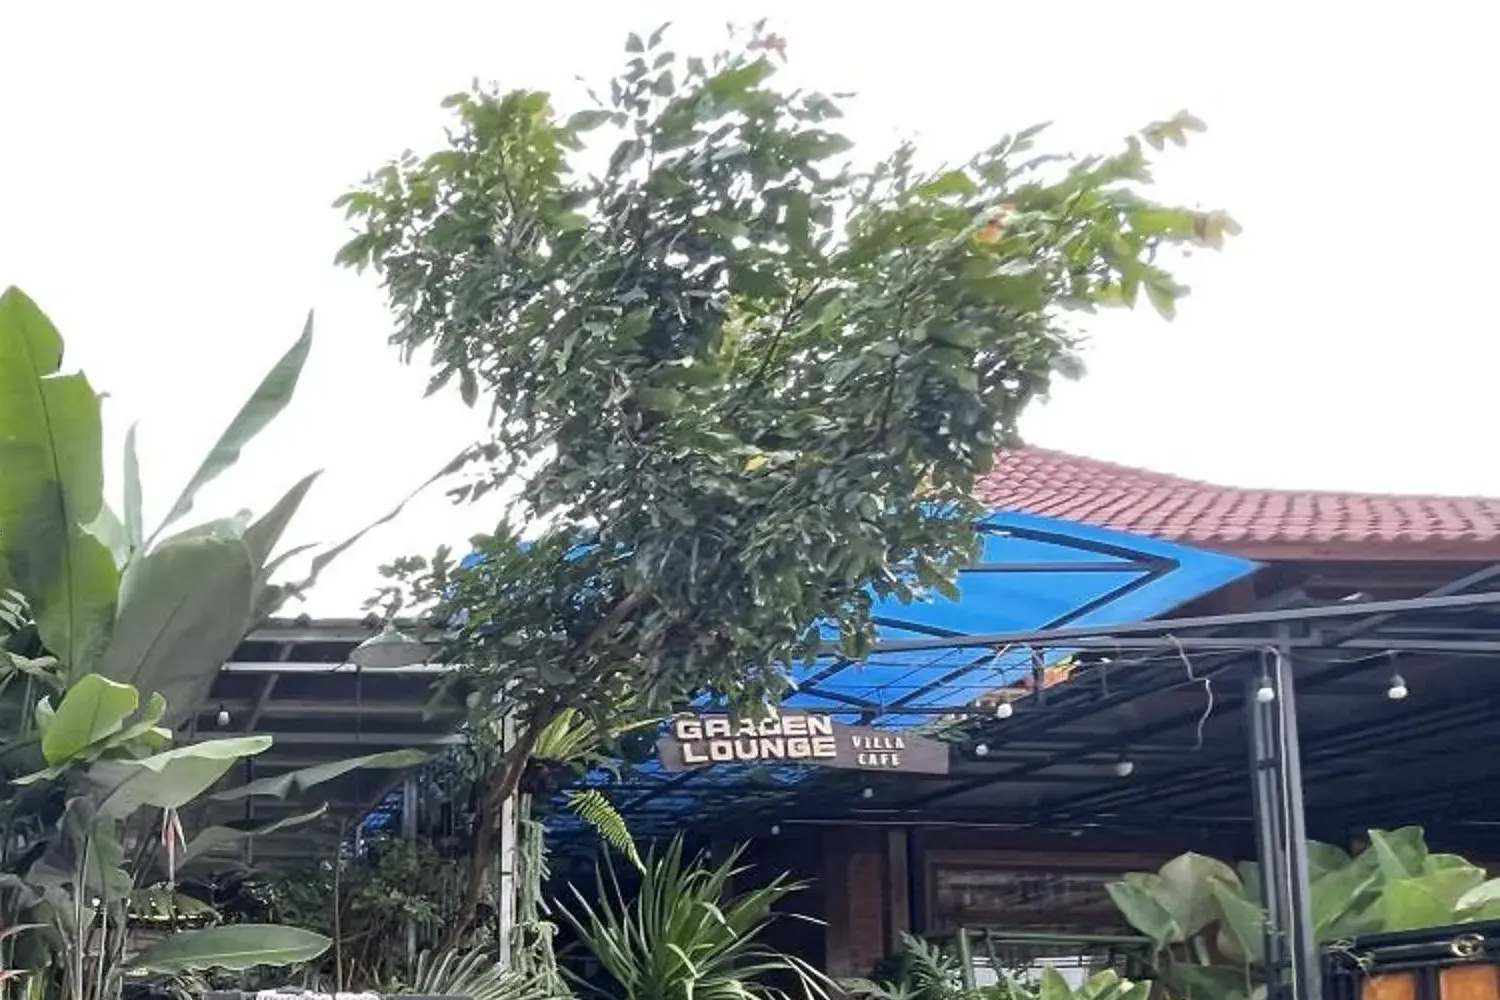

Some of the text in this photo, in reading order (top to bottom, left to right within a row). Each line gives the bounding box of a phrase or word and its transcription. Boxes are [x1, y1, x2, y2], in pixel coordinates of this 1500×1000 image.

[682, 736, 837, 763] LOUNGE
[851, 735, 906, 749] VILLA
[857, 752, 902, 767] CAFE
